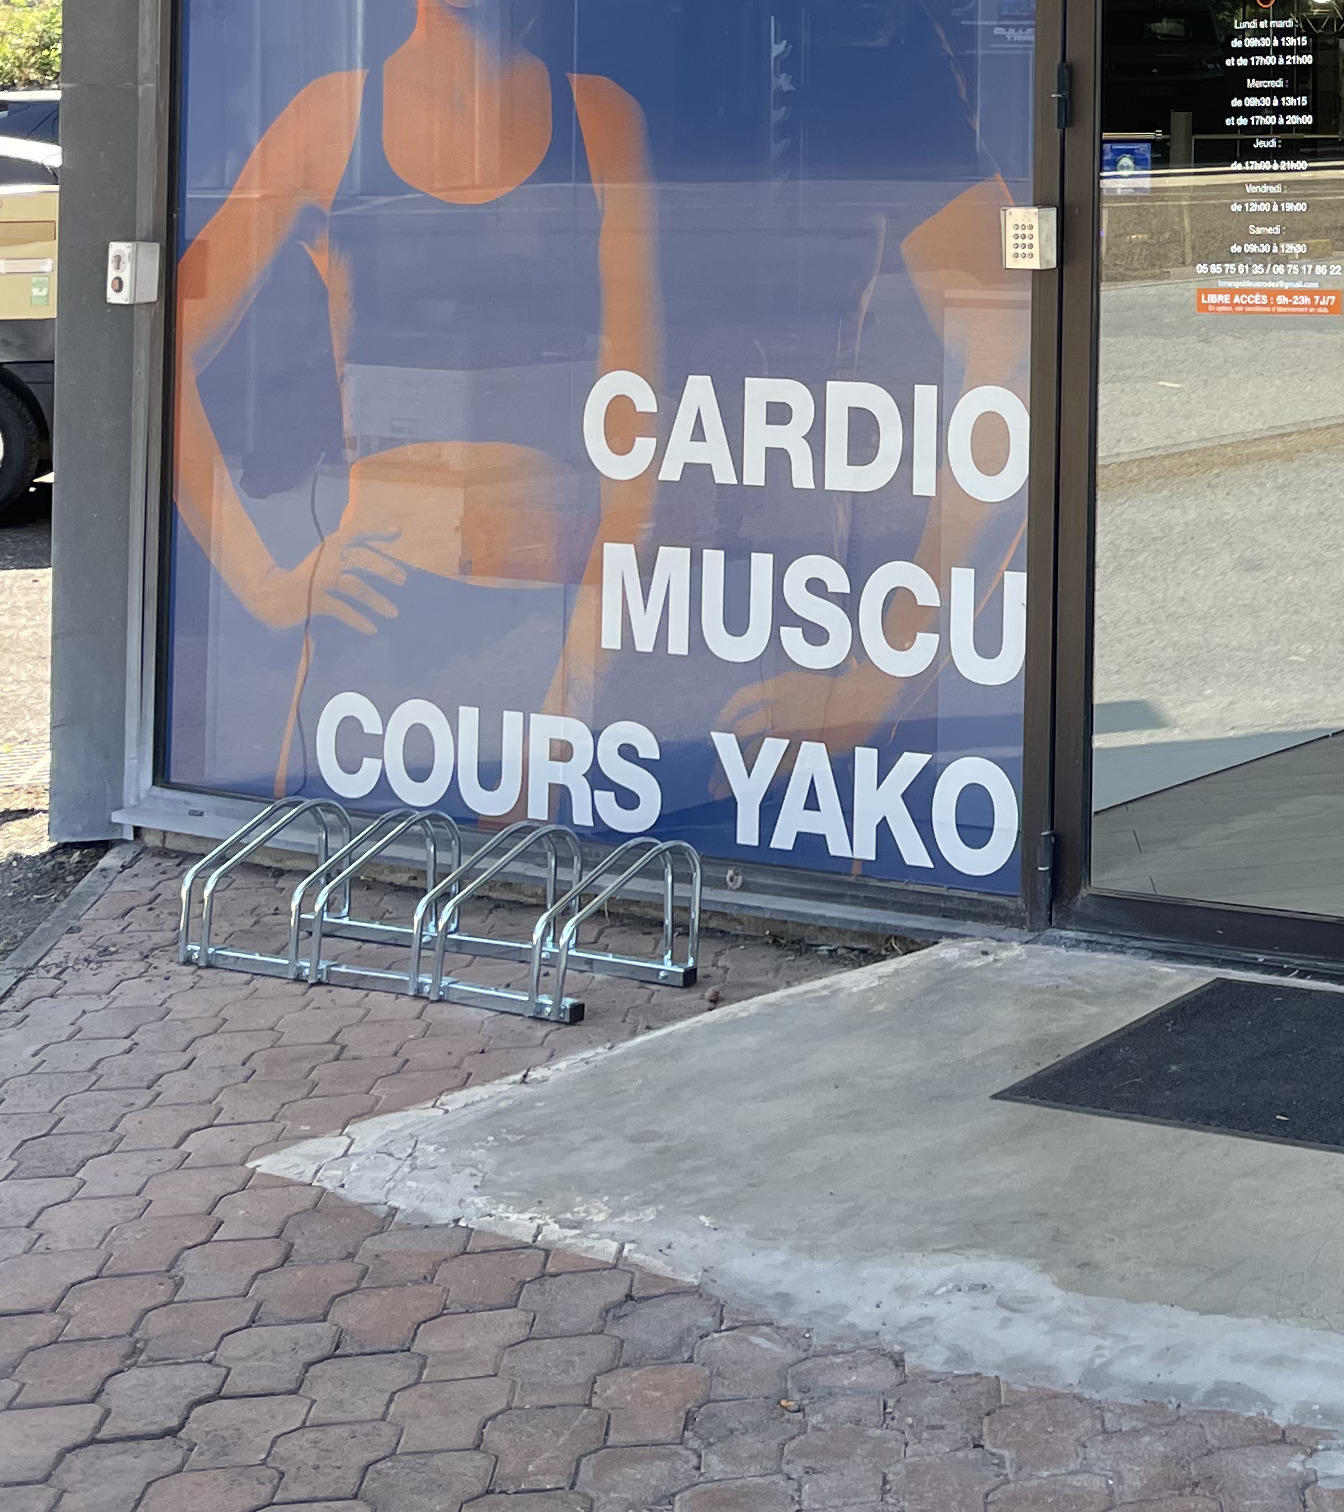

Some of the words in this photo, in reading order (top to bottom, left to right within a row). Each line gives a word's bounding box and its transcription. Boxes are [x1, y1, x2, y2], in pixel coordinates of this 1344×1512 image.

[1234, 19, 1258, 29] Lundi
[1259, 20, 1268, 29] et
[1270, 19, 1294, 28] mardi
[1231, 39, 1242, 48] de
[1273, 35, 1279, 47] à
[1281, 36, 1307, 47] 13h15
[1225, 58, 1235, 67] et
[1237, 56, 1248, 66] de
[1250, 55, 1276, 66] 17h00
[1278, 54, 1285, 65] à
[1286, 54, 1313, 65] 21h00
[1246, 78, 1284, 88] Mercredi
[1231, 98, 1242, 107] de
[1272, 95, 1279, 106] à
[1281, 96, 1308, 106] 13h15
[1225, 117, 1235, 126] et
[1237, 116, 1248, 126] de
[1250, 115, 1276, 125] 17h00
[1278, 114, 1285, 125] à
[1286, 114, 1313, 125] 20h00
[1253, 137, 1277, 148] Jeudi
[1231, 160, 1242, 170] de
[1245, 160, 1271, 170] 17h00
[1272, 159, 1279, 170] à
[1280, 160, 1308, 170] 21h00
[1245, 183, 1282, 193] Vendredi
[1231, 202, 1242, 212] de
[1245, 202, 1271, 212] 12h00
[1272, 200, 1279, 212] à
[1281, 202, 1307, 212] 19h00
[1249, 225, 1281, 235] Samedi
[1230, 243, 1242, 253] de
[1272, 241, 1279, 253] à
[1280, 243, 1307, 253] 12h30
[1201, 294, 1231, 304] LIBRE
[582, 370, 1030, 503] CARDIO
[601, 542, 1027, 686] MUSCU
[316, 692, 662, 834] COURS
[710, 731, 1019, 877] YAKO
